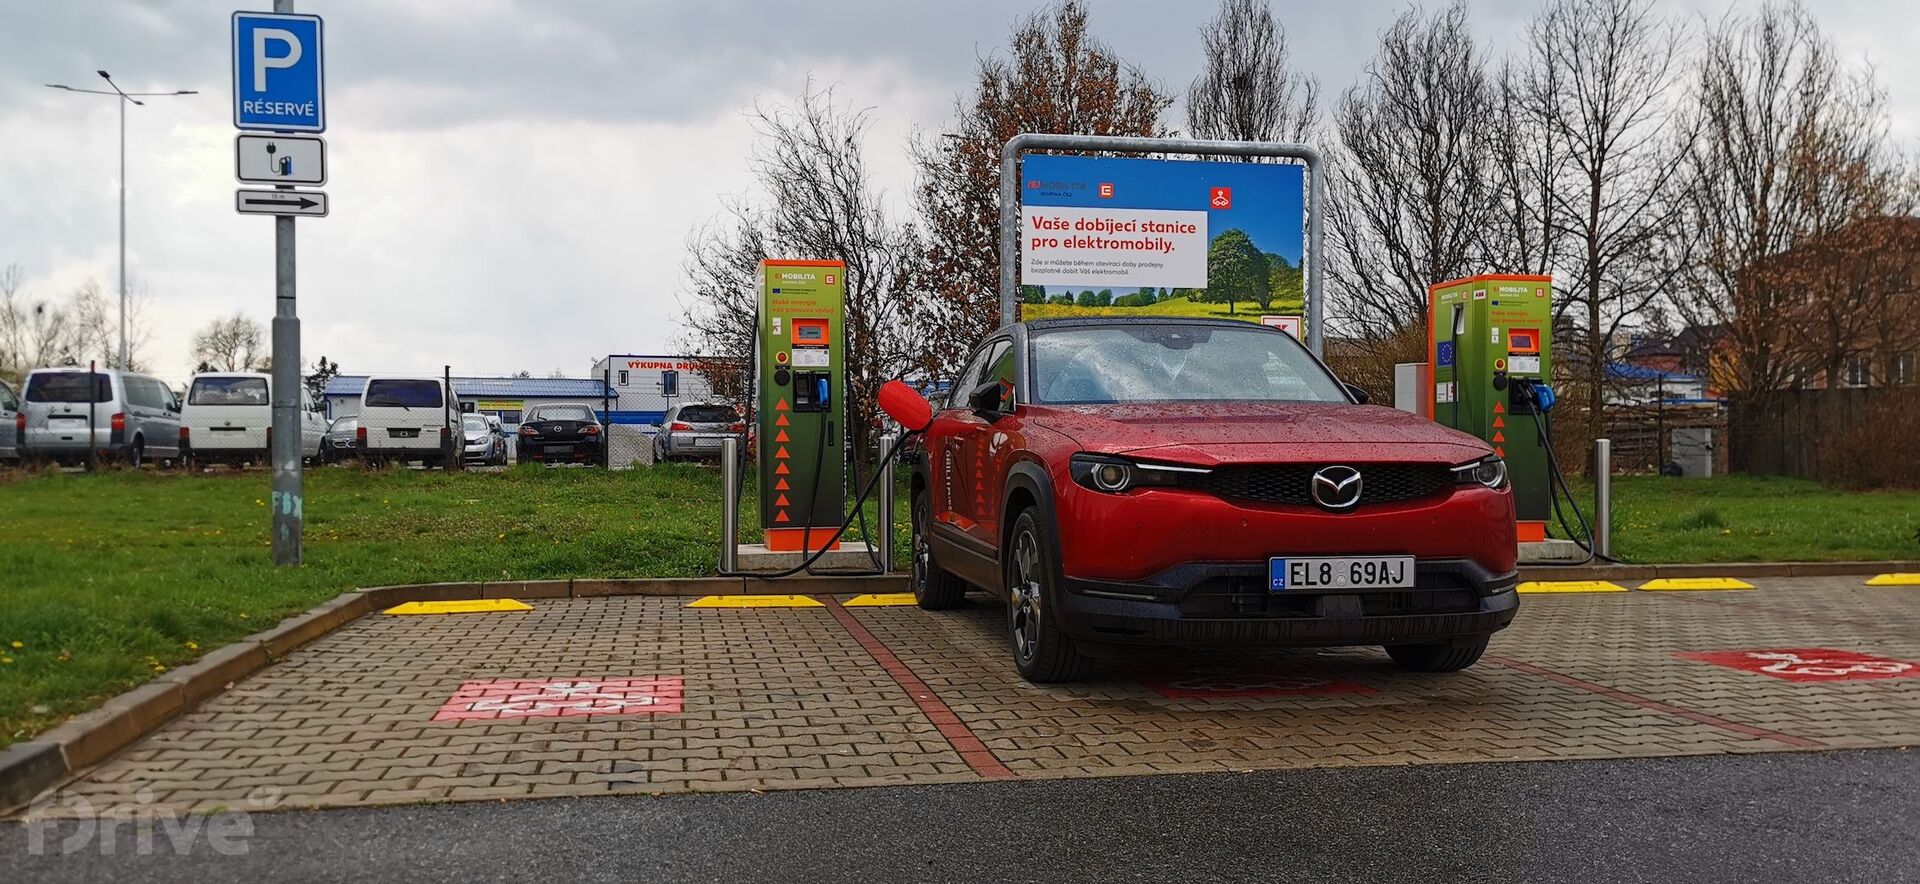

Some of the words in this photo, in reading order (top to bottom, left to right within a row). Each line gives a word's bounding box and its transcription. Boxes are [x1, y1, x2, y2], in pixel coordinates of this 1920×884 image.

[253, 27, 302, 92] P
[243, 98, 314, 116] RÉSERVÉ
[1032, 216, 1070, 230] Vaše
[1075, 218, 1136, 235] dobíjecí
[1141, 220, 1196, 234] stanice
[1032, 237, 1058, 250] pro
[1063, 235, 1175, 254] elektromobily.
[1138, 261, 1163, 269] prodejny
[628, 360, 673, 369] VÝKUPNA
[1272, 578, 1284, 587] CZ
[1290, 562, 1332, 586] EL8
[1350, 561, 1405, 585] 69AJ
